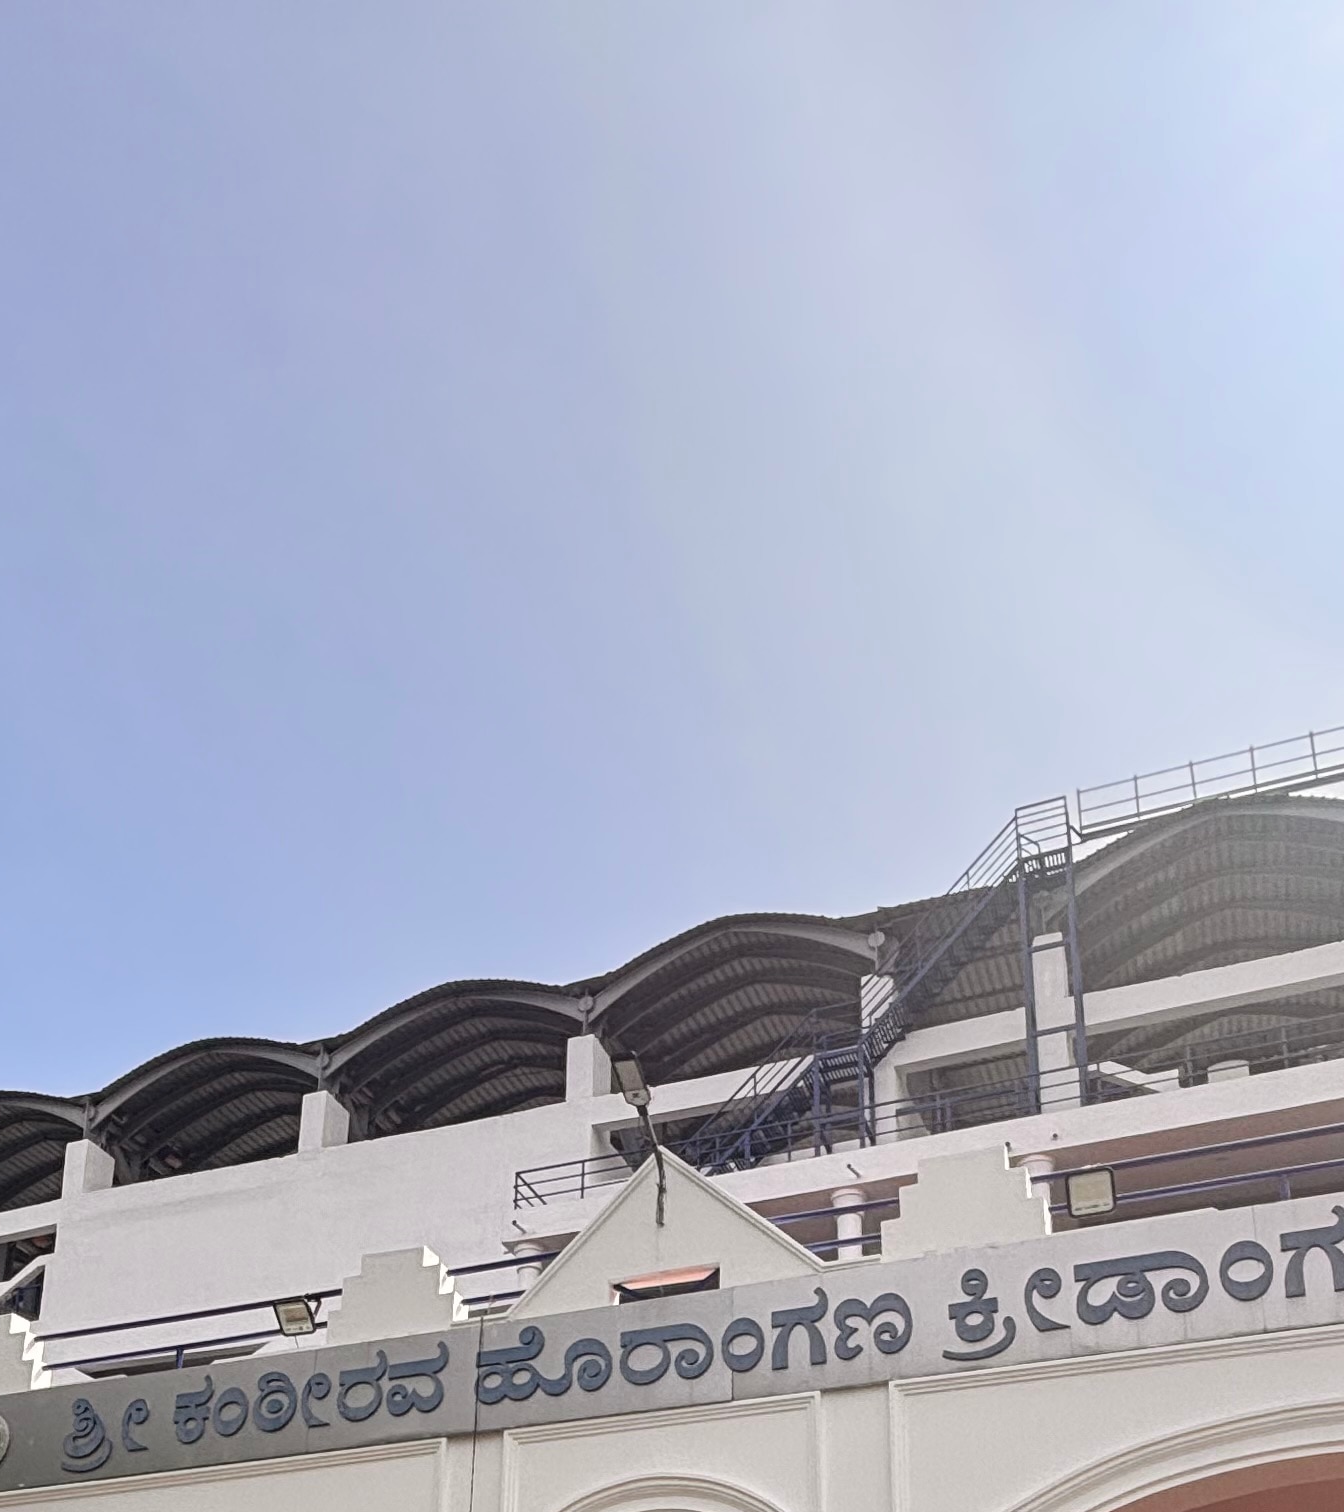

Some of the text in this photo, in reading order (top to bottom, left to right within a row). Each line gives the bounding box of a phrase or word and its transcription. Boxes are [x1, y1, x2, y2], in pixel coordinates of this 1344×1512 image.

[61, 1397, 150, 1473] ಶ್ರೀ
[173, 1340, 450, 1445] ಕಂಠೀರವ
[475, 1286, 914, 1405] ಹೊರಾಂಗಣ
